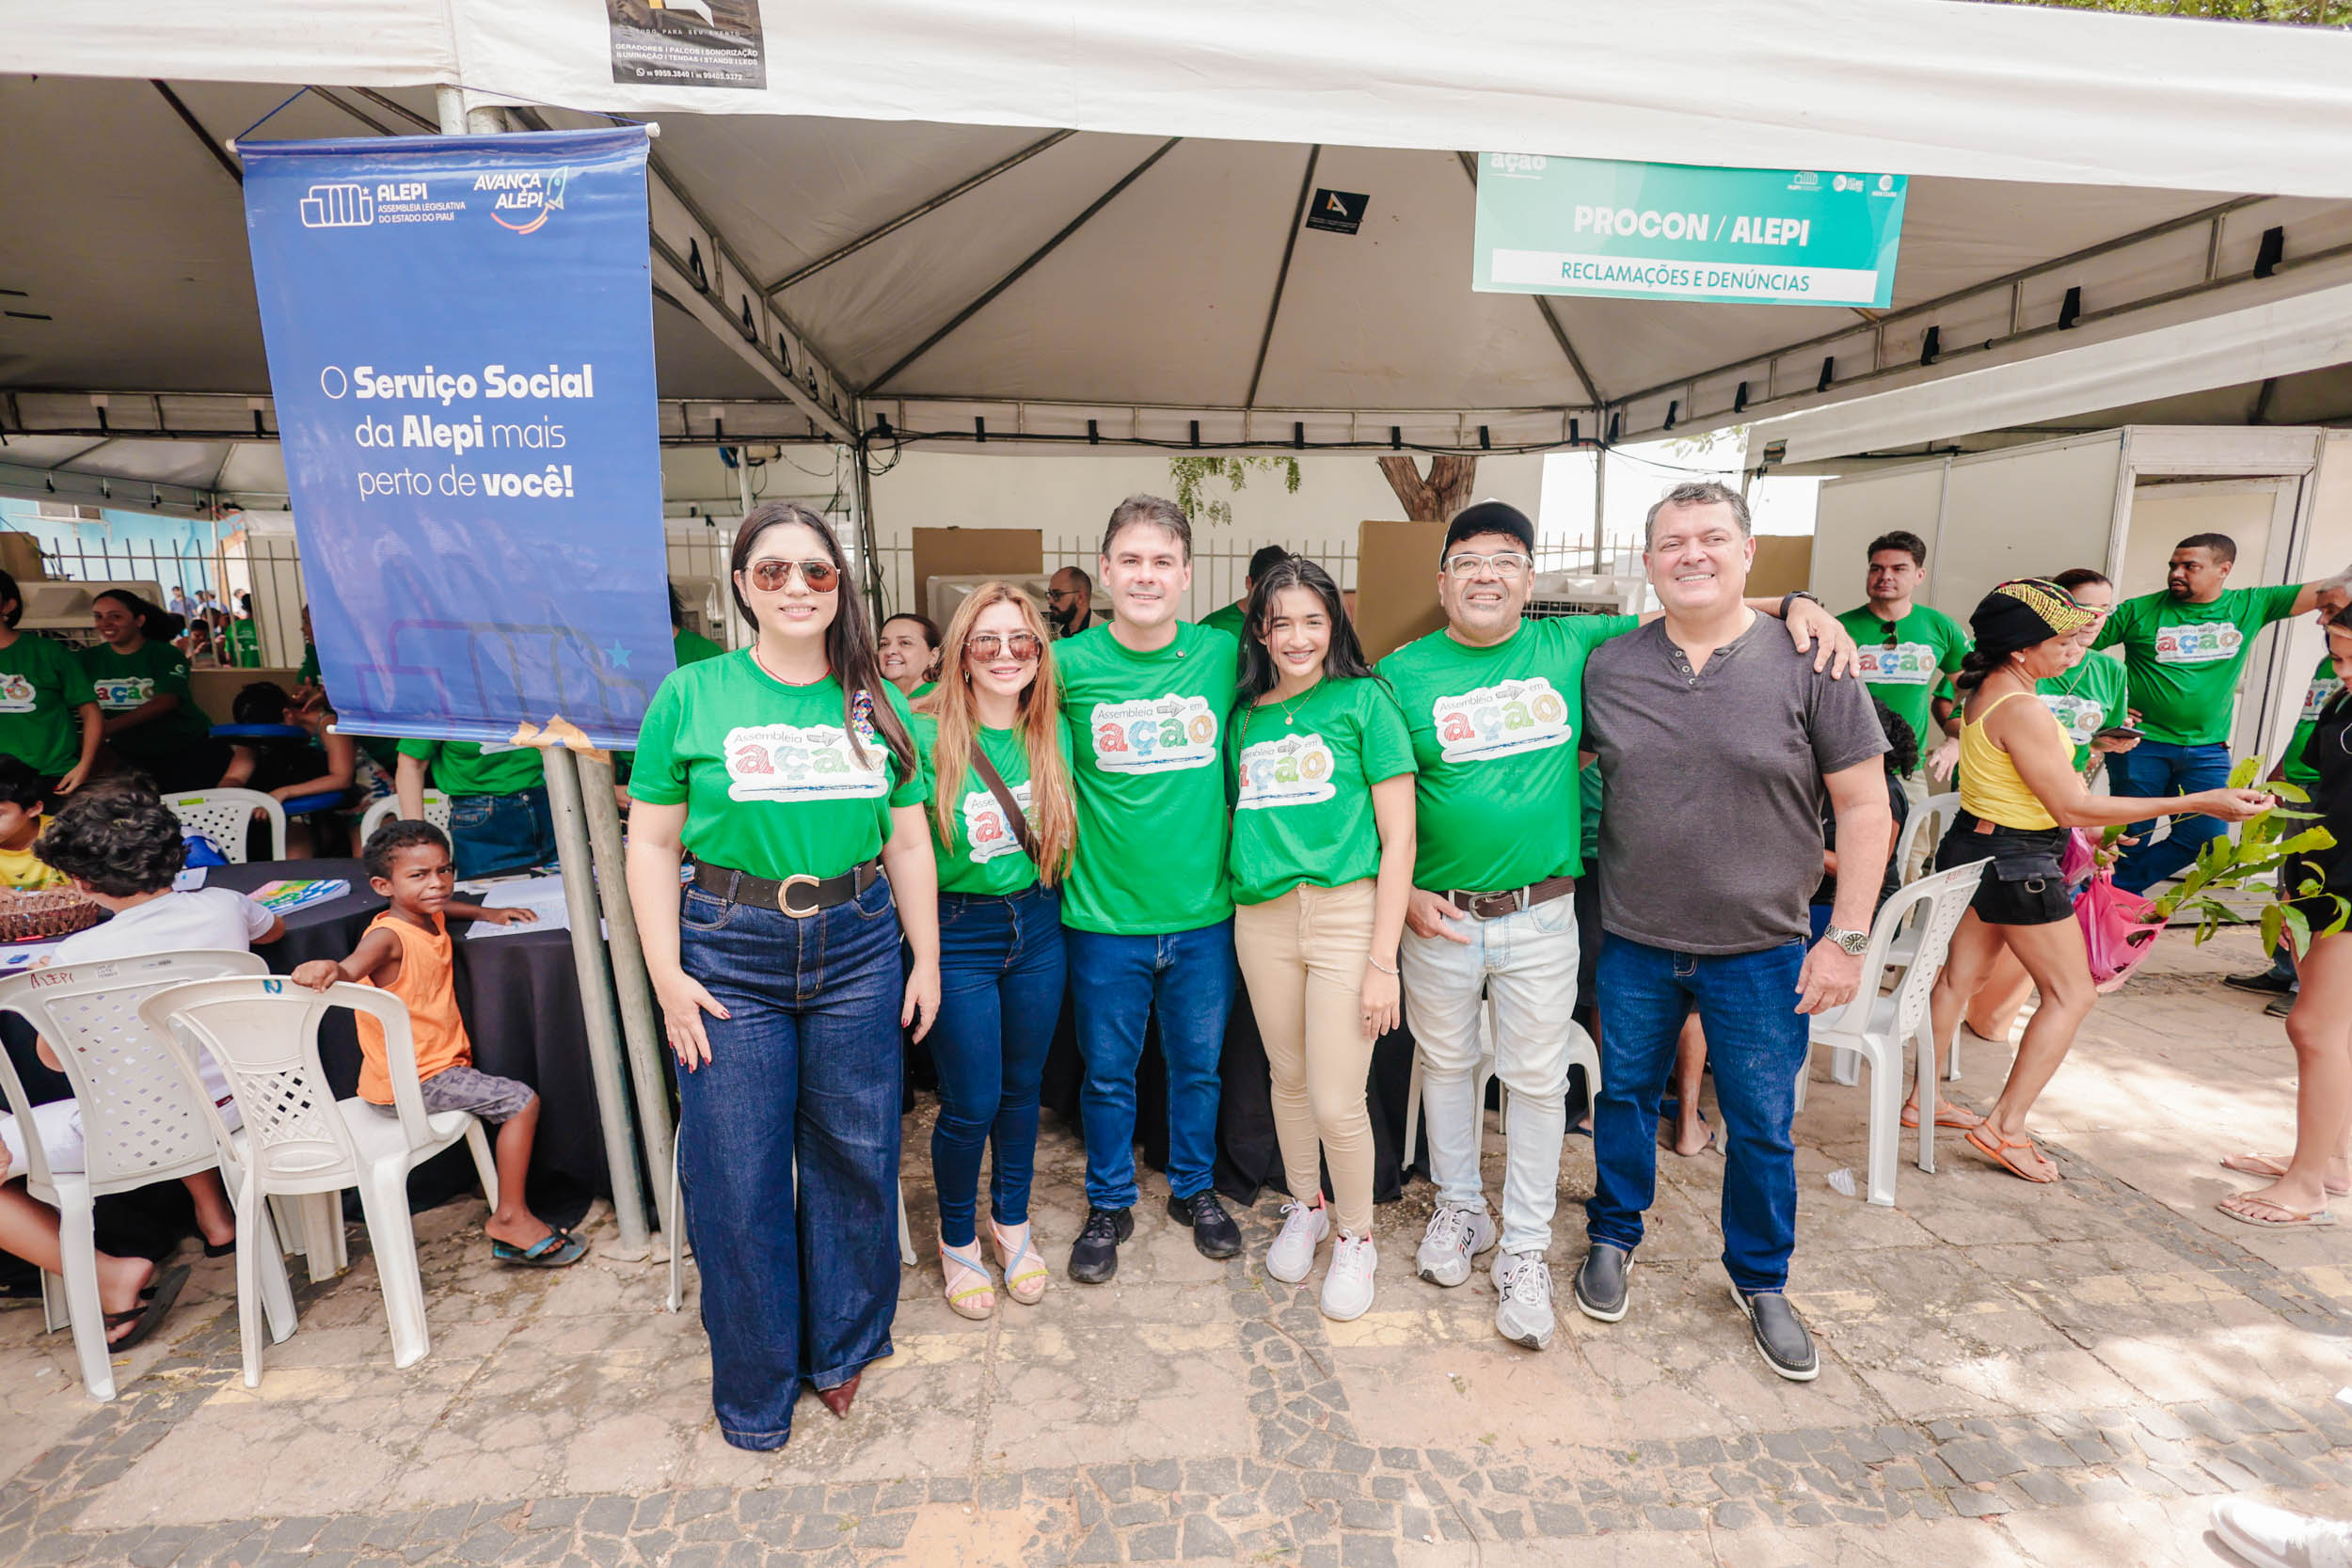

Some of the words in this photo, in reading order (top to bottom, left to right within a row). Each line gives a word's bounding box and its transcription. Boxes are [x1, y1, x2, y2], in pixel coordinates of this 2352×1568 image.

[615, 43, 663, 52] GERADORES
[706, 48, 758, 57] SONORIZAÇÃO
[376, 182, 427, 202] ALEPI
[473, 172, 542, 193] AVANÇA
[378, 203, 421, 213] ASSEMBLEIA
[421, 201, 466, 211] LEGISLATIVA
[378, 214, 390, 223] DO
[391, 214, 421, 223] ESTADO
[422, 213, 434, 222] DO
[436, 212, 454, 221] PIAUÍ
[1574, 205, 1709, 242] PROCON
[1731, 216, 1811, 246] ALEPI
[1562, 261, 1690, 289] RECLAMAÇÕES
[1694, 271, 1702, 287] E
[1708, 271, 1810, 292] DENÚNCIAS
[321, 365, 347, 399] O
[354, 365, 477, 406] Serviço
[484, 364, 594, 399] Social
[355, 415, 394, 448] da
[402, 415, 485, 455] Alepi
[491, 415, 565, 449] mais
[358, 467, 432, 501] perto
[438, 464, 476, 496] de
[482, 464, 574, 498] você!
[1439, 693, 1493, 711] Assembleia
[1529, 683, 1544, 692] em
[1098, 706, 1153, 720] Assembleia
[734, 731, 803, 744] Assembleia
[1459, 1227, 1475, 1259] FILA
